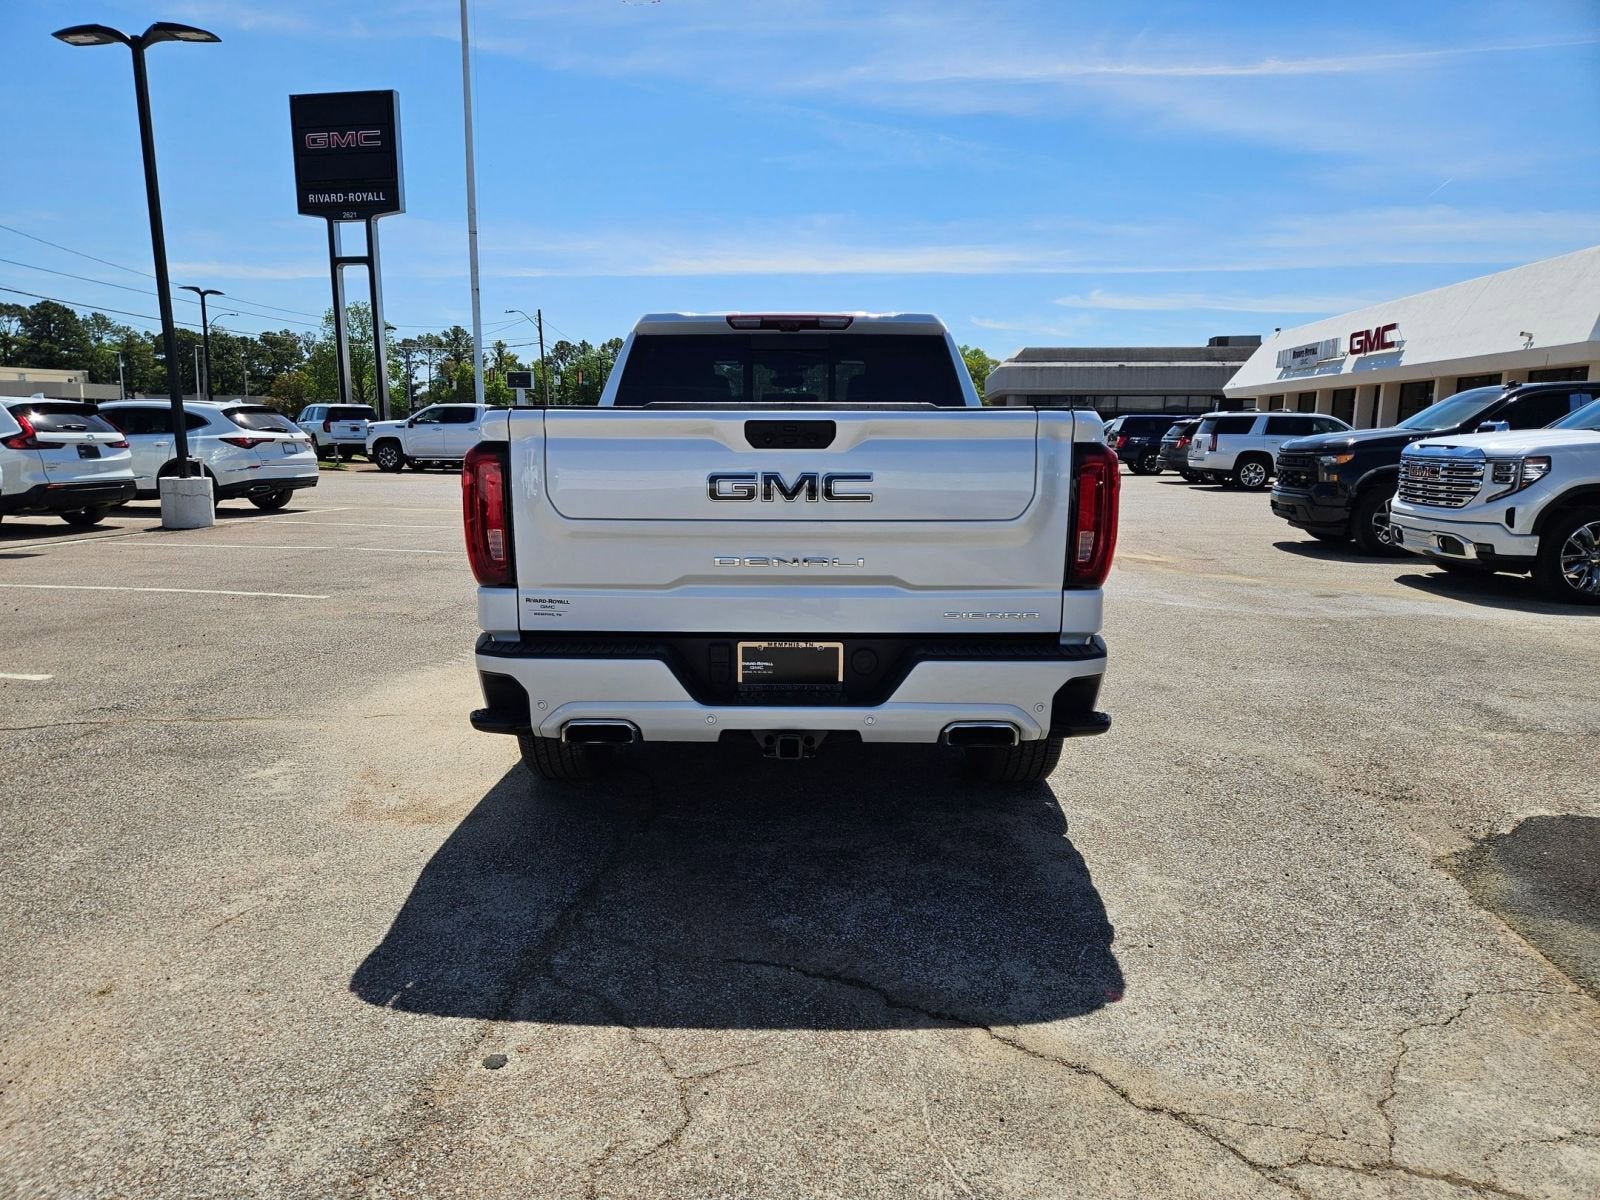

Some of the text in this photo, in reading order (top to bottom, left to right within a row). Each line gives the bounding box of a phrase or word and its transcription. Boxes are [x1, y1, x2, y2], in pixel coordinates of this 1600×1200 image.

[305, 130, 382, 149] GMC
[308, 191, 386, 203] RIVARD-ROYALL
[1350, 323, 1398, 355] GMC
[706, 471, 874, 503] GMC
[714, 556, 865, 568] DENALI
[943, 611, 1040, 621] SIERRA
